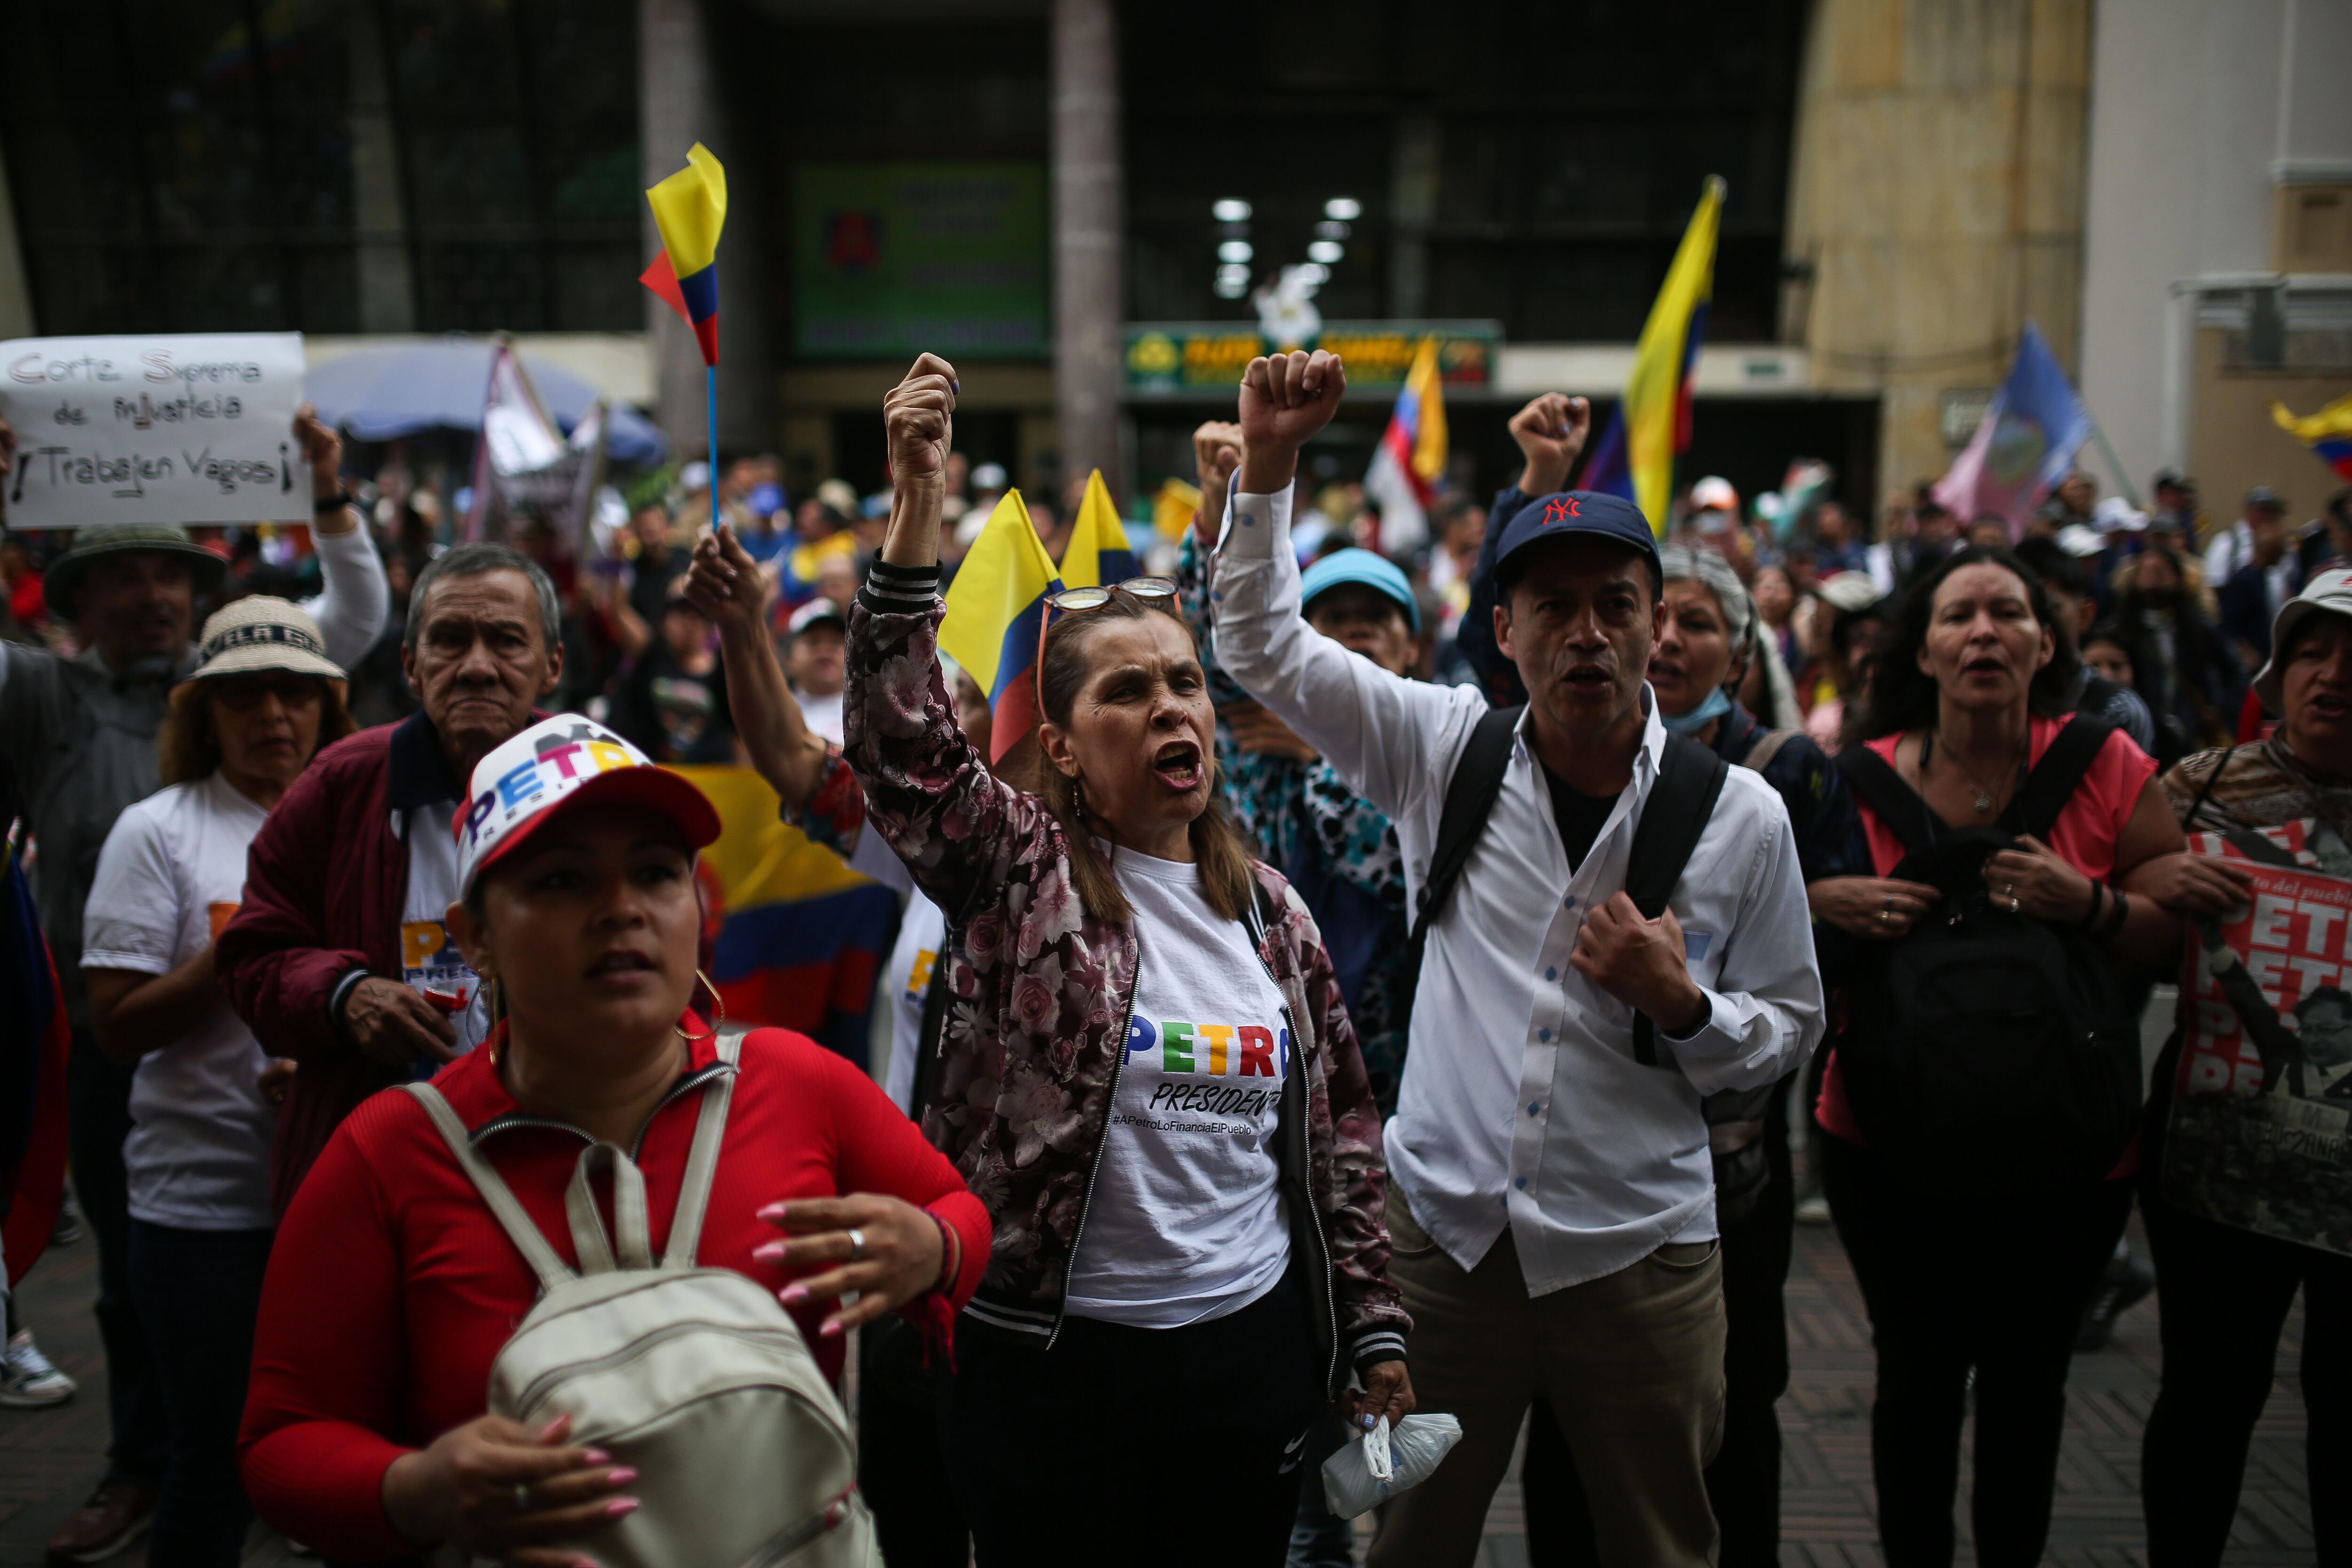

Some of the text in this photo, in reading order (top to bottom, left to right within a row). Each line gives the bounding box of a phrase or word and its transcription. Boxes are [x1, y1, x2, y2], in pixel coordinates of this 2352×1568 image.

[8, 352, 120, 383] Corte
[53, 400, 89, 426] de
[1543, 497, 1581, 525] NY
[1112, 1114, 1252, 1135] #APetroLoFinanciaElPueblo
